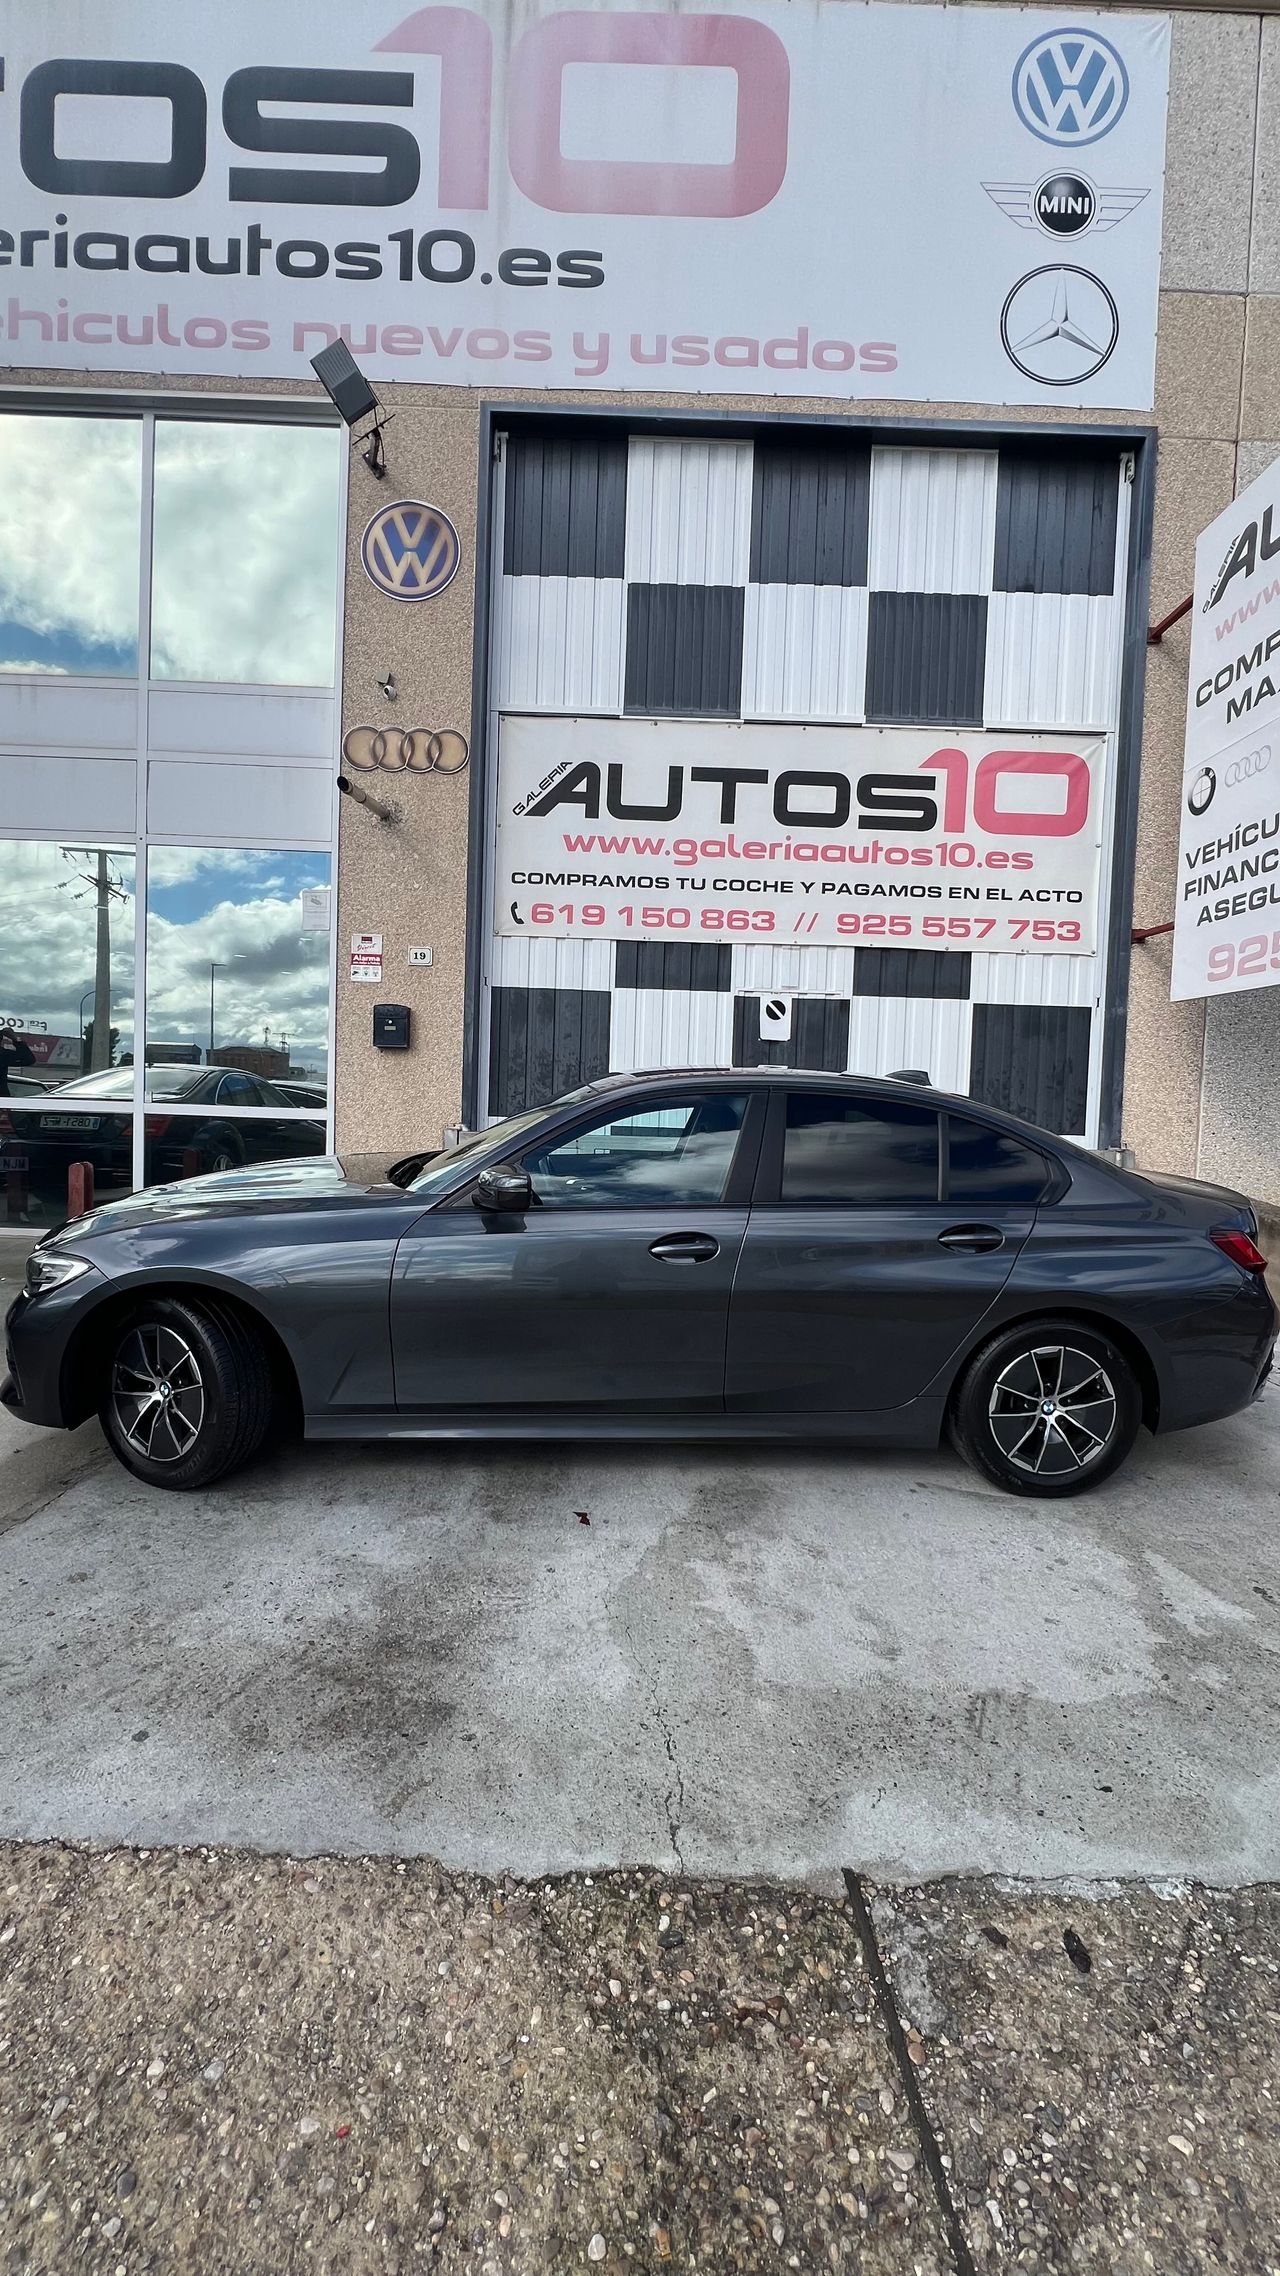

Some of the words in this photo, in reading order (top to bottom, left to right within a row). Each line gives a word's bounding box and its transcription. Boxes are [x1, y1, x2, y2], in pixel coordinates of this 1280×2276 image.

[0, 6, 789, 219] OS10
[1039, 195, 1091, 215] MINI
[0, 213, 606, 289] riaautos10.es
[0, 298, 270, 352] hiculos
[293, 321, 552, 362] nuevos
[573, 332, 610, 377] y
[630, 327, 898, 374] usados
[512, 761, 573, 816] GALERIA
[563, 832, 1034, 871] www.galeriaautos10.es
[511, 872, 670, 889] COMPRAMOS
[676, 877, 706, 891] TU
[713, 879, 794, 893] COCHE
[799, 881, 816, 895] Y
[821, 882, 942, 899] PAGAMOS
[948, 887, 980, 900] EN
[986, 888, 1013, 901] EL
[1019, 889, 1083, 903] ACTO
[1184, 848, 1280, 902] FINANC
[530, 903, 606, 927] 619
[618, 905, 691, 929] 150
[700, 908, 776, 932] 863
[836, 913, 913, 937] 925
[922, 916, 997, 939] 557
[1007, 919, 1082, 943] 753
[352, 954, 381, 962] Alarma
[413, 952, 427, 961] 19
